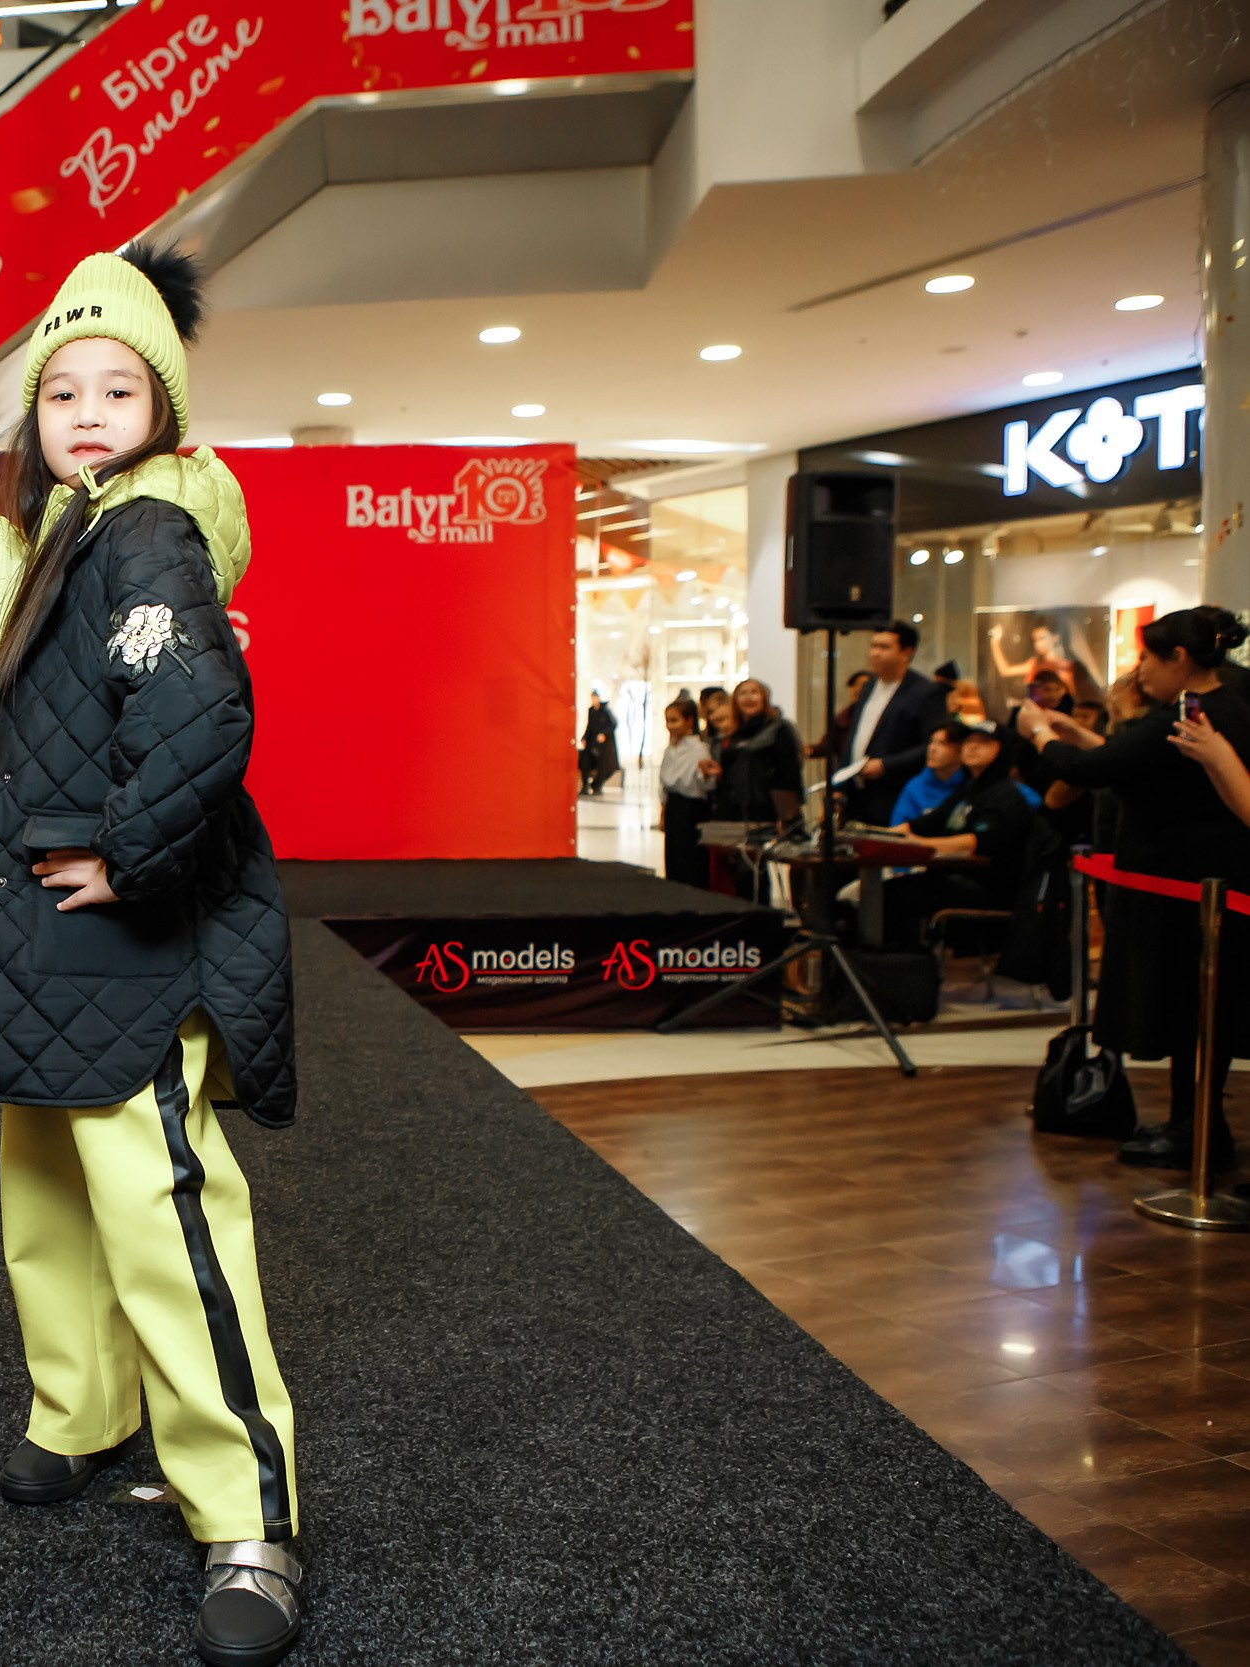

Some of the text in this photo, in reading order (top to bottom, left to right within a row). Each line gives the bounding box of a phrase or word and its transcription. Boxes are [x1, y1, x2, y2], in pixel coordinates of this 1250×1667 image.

[498, 14, 584, 47] mall
[102, 14, 219, 111] Бірге
[60, 16, 263, 219] Вместе
[44, 305, 103, 337] FLWR
[346, 484, 456, 543] Batyr
[439, 523, 493, 543] mall
[416, 941, 575, 993] AS models
[601, 939, 761, 990] AS models
